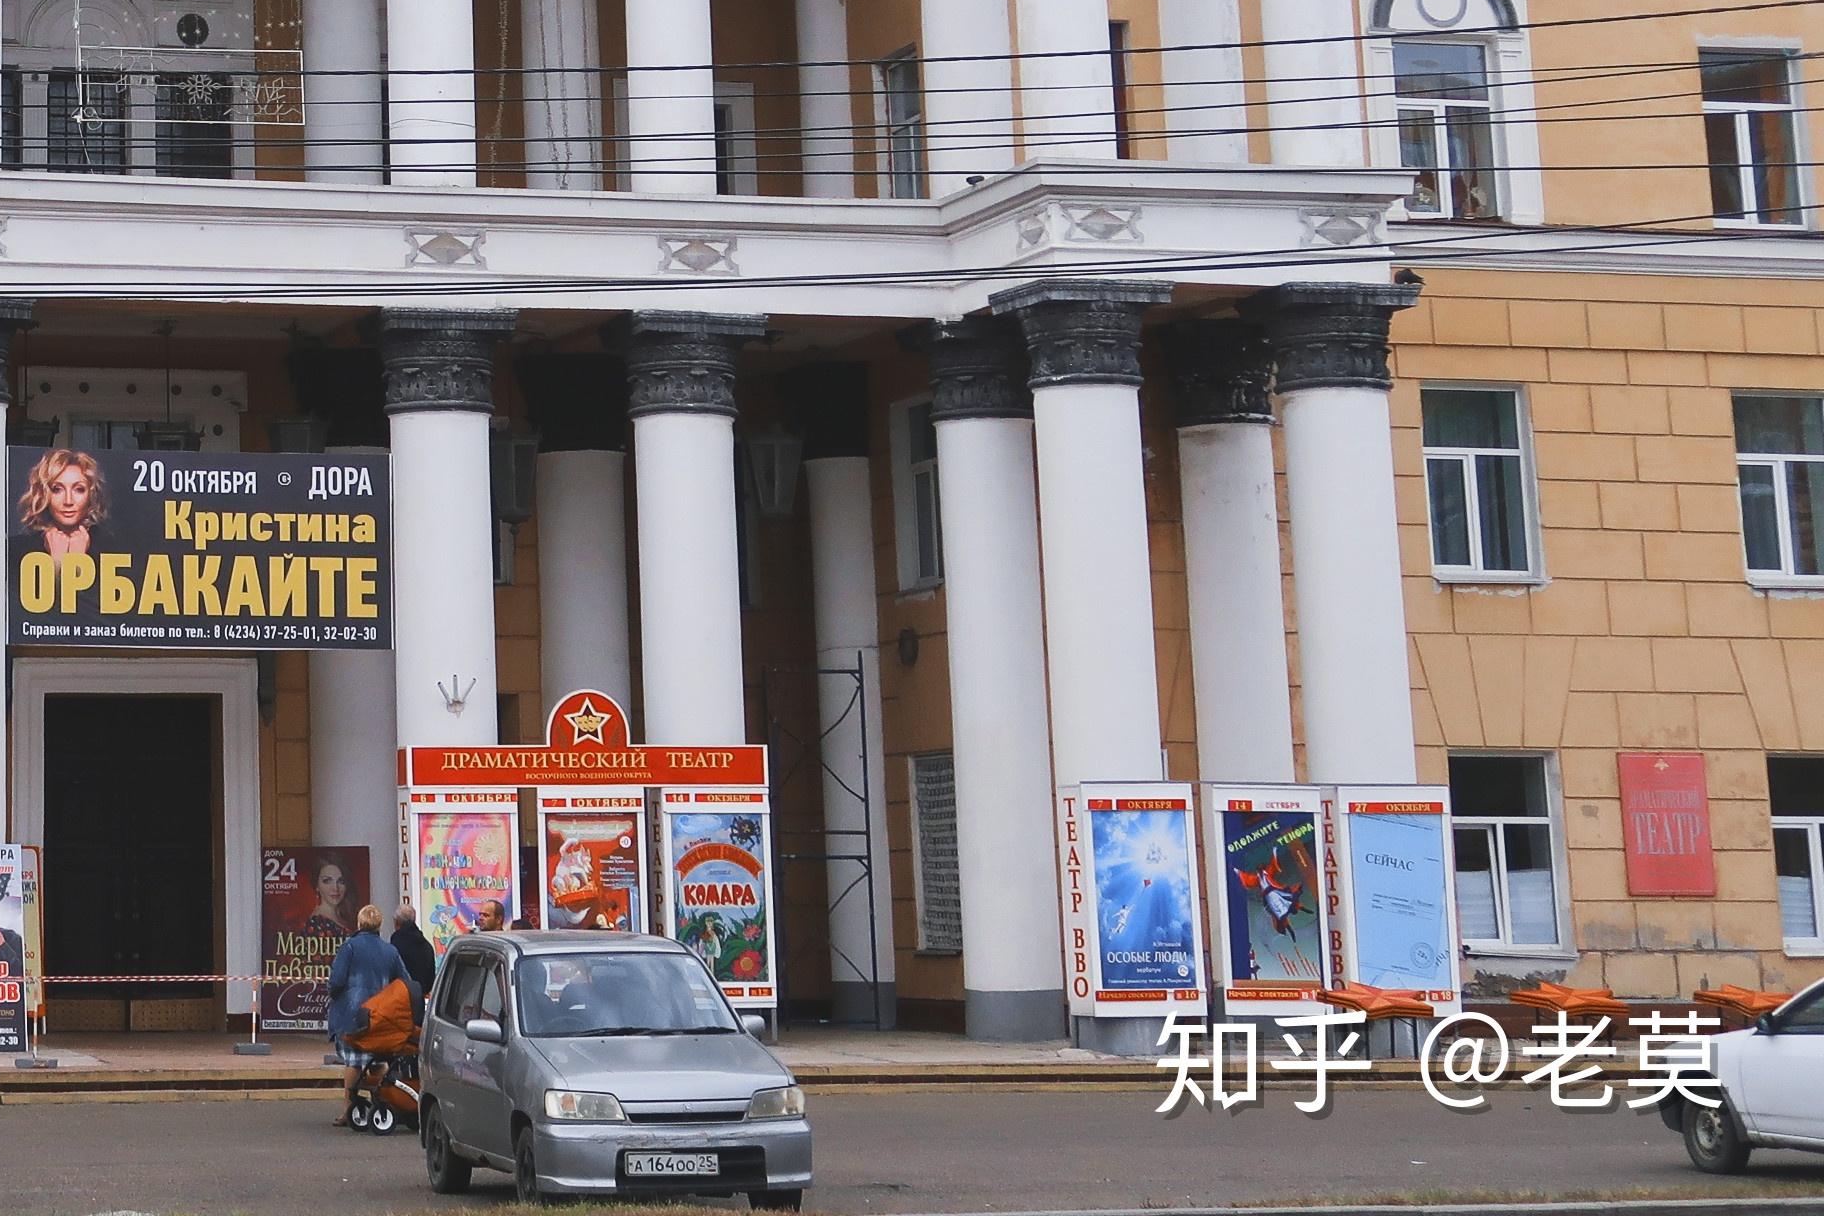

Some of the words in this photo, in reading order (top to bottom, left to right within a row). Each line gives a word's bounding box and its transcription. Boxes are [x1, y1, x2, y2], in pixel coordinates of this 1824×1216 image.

[134, 461, 164, 492] 20
[171, 469, 257, 495] ОКТЯБРЯ
[308, 467, 373, 500] ДОРА
[164, 501, 376, 550] Кристина
[20, 551, 378, 617] ОРБАКАЙТЕ
[22, 622, 70, 638] Справки
[74, 625, 81, 636] и
[84, 625, 116, 637] заказ
[120, 623, 165, 638] билетов
[168, 627, 182, 638] по
[214, 625, 221, 638] 8
[224, 625, 261, 641] (4234)
[264, 626, 320, 641] 37-25-01,
[324, 626, 377, 640] 32-02-30
[441, 748, 647, 771] ДРАМАТИЧЕСКИЙ
[666, 751, 734, 769] ТЕАТР
[420, 794, 427, 802] 6
[452, 794, 511, 802] ОКТЯБРЯ
[576, 799, 636, 807] ОКТЯБРЯ
[673, 794, 684, 802] 14
[707, 794, 752, 802] ОКТЯБРЯ
[1097, 801, 1103, 809] 7
[1128, 800, 1172, 809] ОКТЯБРЯ
[1266, 801, 1300, 809] ОКТЯБРЯ
[1355, 804, 1367, 812] 27
[1386, 803, 1431, 812] ОКТЯБРЯ
[1228, 821, 1280, 852] ОДОЛЖИТЕ
[1277, 823, 1314, 846] ТЕНОРА
[1632, 812, 1704, 855] ТЕАТР
[652, 801, 663, 912] ТЕАТР
[1321, 800, 1339, 915] ТЕАТР
[1365, 853, 1415, 872] СЕЙЧАС
[265, 858, 297, 881] 24
[264, 882, 298, 890] ОКТЯБРЯ
[683, 883, 756, 906] КОМАРА
[1064, 798, 1082, 913] ТЕАТР
[1073, 929, 1089, 998] ВВО
[276, 931, 349, 963] Марин
[1107, 951, 1151, 963] ОСОБЫЕ
[1153, 951, 1187, 965] ЛЮДИ
[1098, 992, 1126, 1000] Начало
[1185, 990, 1196, 998] 16
[1440, 991, 1452, 1001] 18
[698, 1156, 713, 1167] 25
